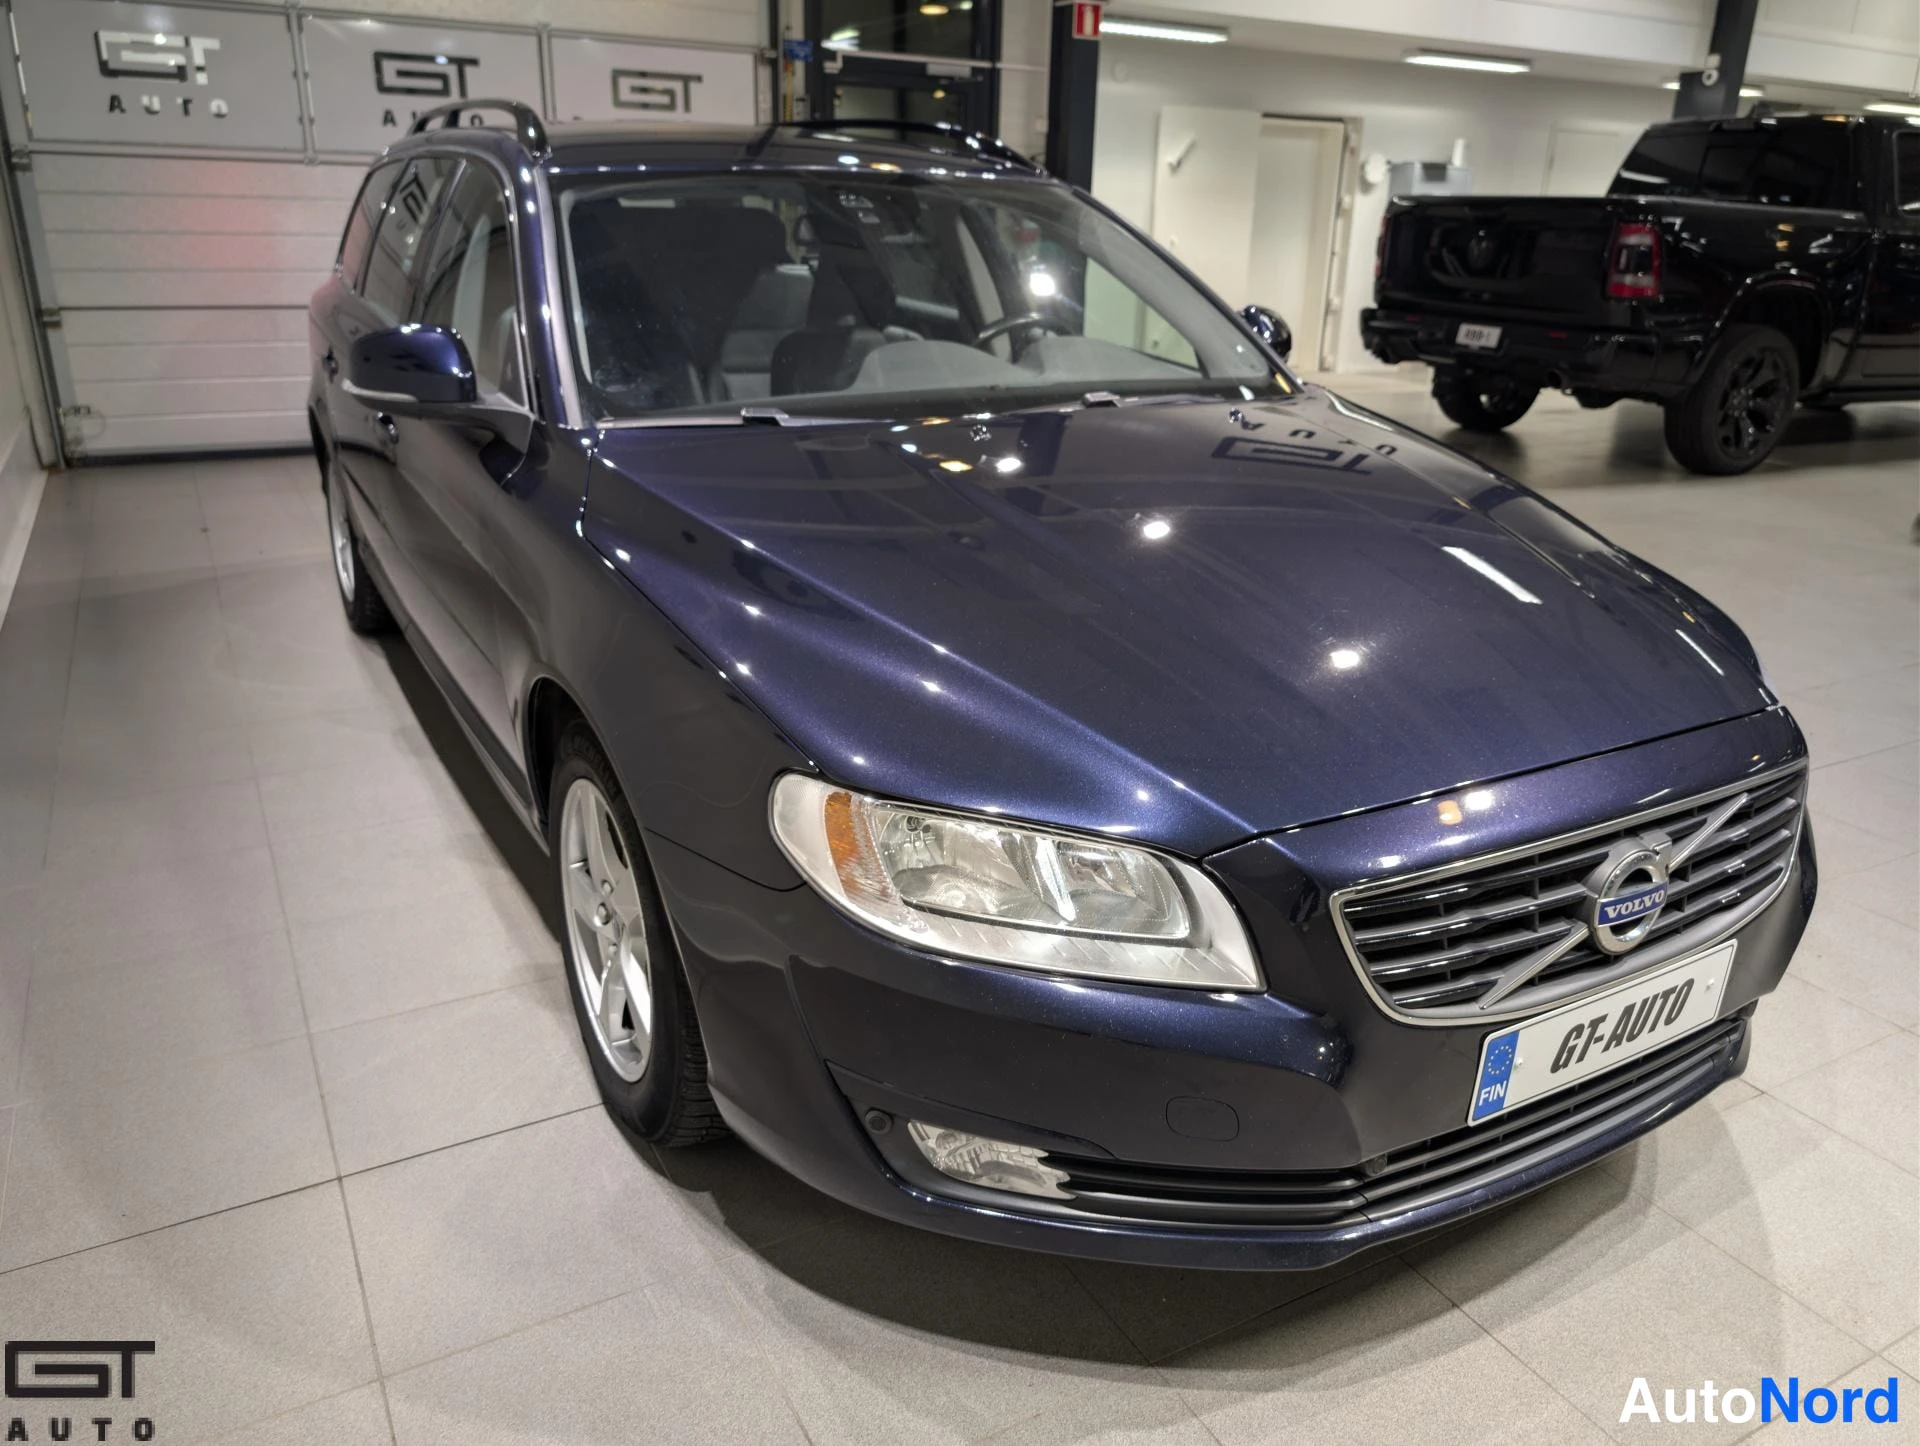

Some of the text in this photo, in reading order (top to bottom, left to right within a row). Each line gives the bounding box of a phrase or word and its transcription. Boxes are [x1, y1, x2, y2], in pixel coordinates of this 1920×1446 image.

[94, 30, 220, 85] GT
[374, 52, 480, 98] GT
[108, 94, 229, 119] AUTO
[612, 69, 703, 114] GT
[1604, 889, 1665, 919] VOLVO
[1549, 977, 1695, 1074] GT-AUTO
[1478, 1080, 1508, 1106] FIN
